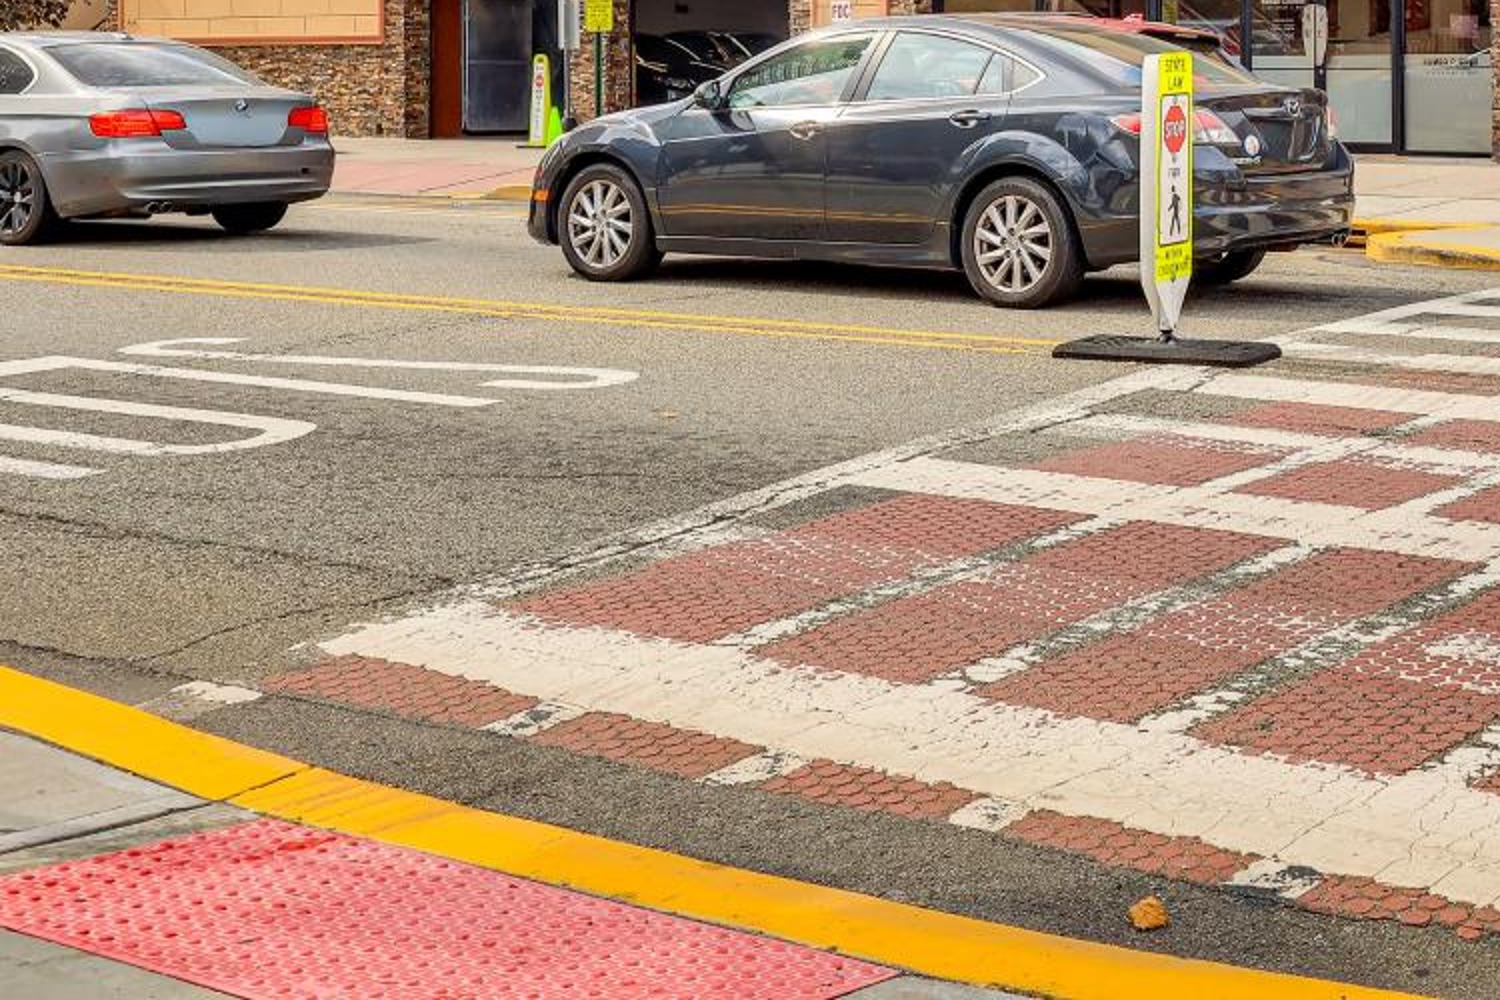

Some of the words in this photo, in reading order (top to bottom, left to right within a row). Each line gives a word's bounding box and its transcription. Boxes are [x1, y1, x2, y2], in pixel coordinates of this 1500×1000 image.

[1165, 58, 1186, 72] STATE
[1167, 76, 1184, 90] LAW
[1165, 122, 1184, 138] STOP
[0, 335, 638, 480] SLO
